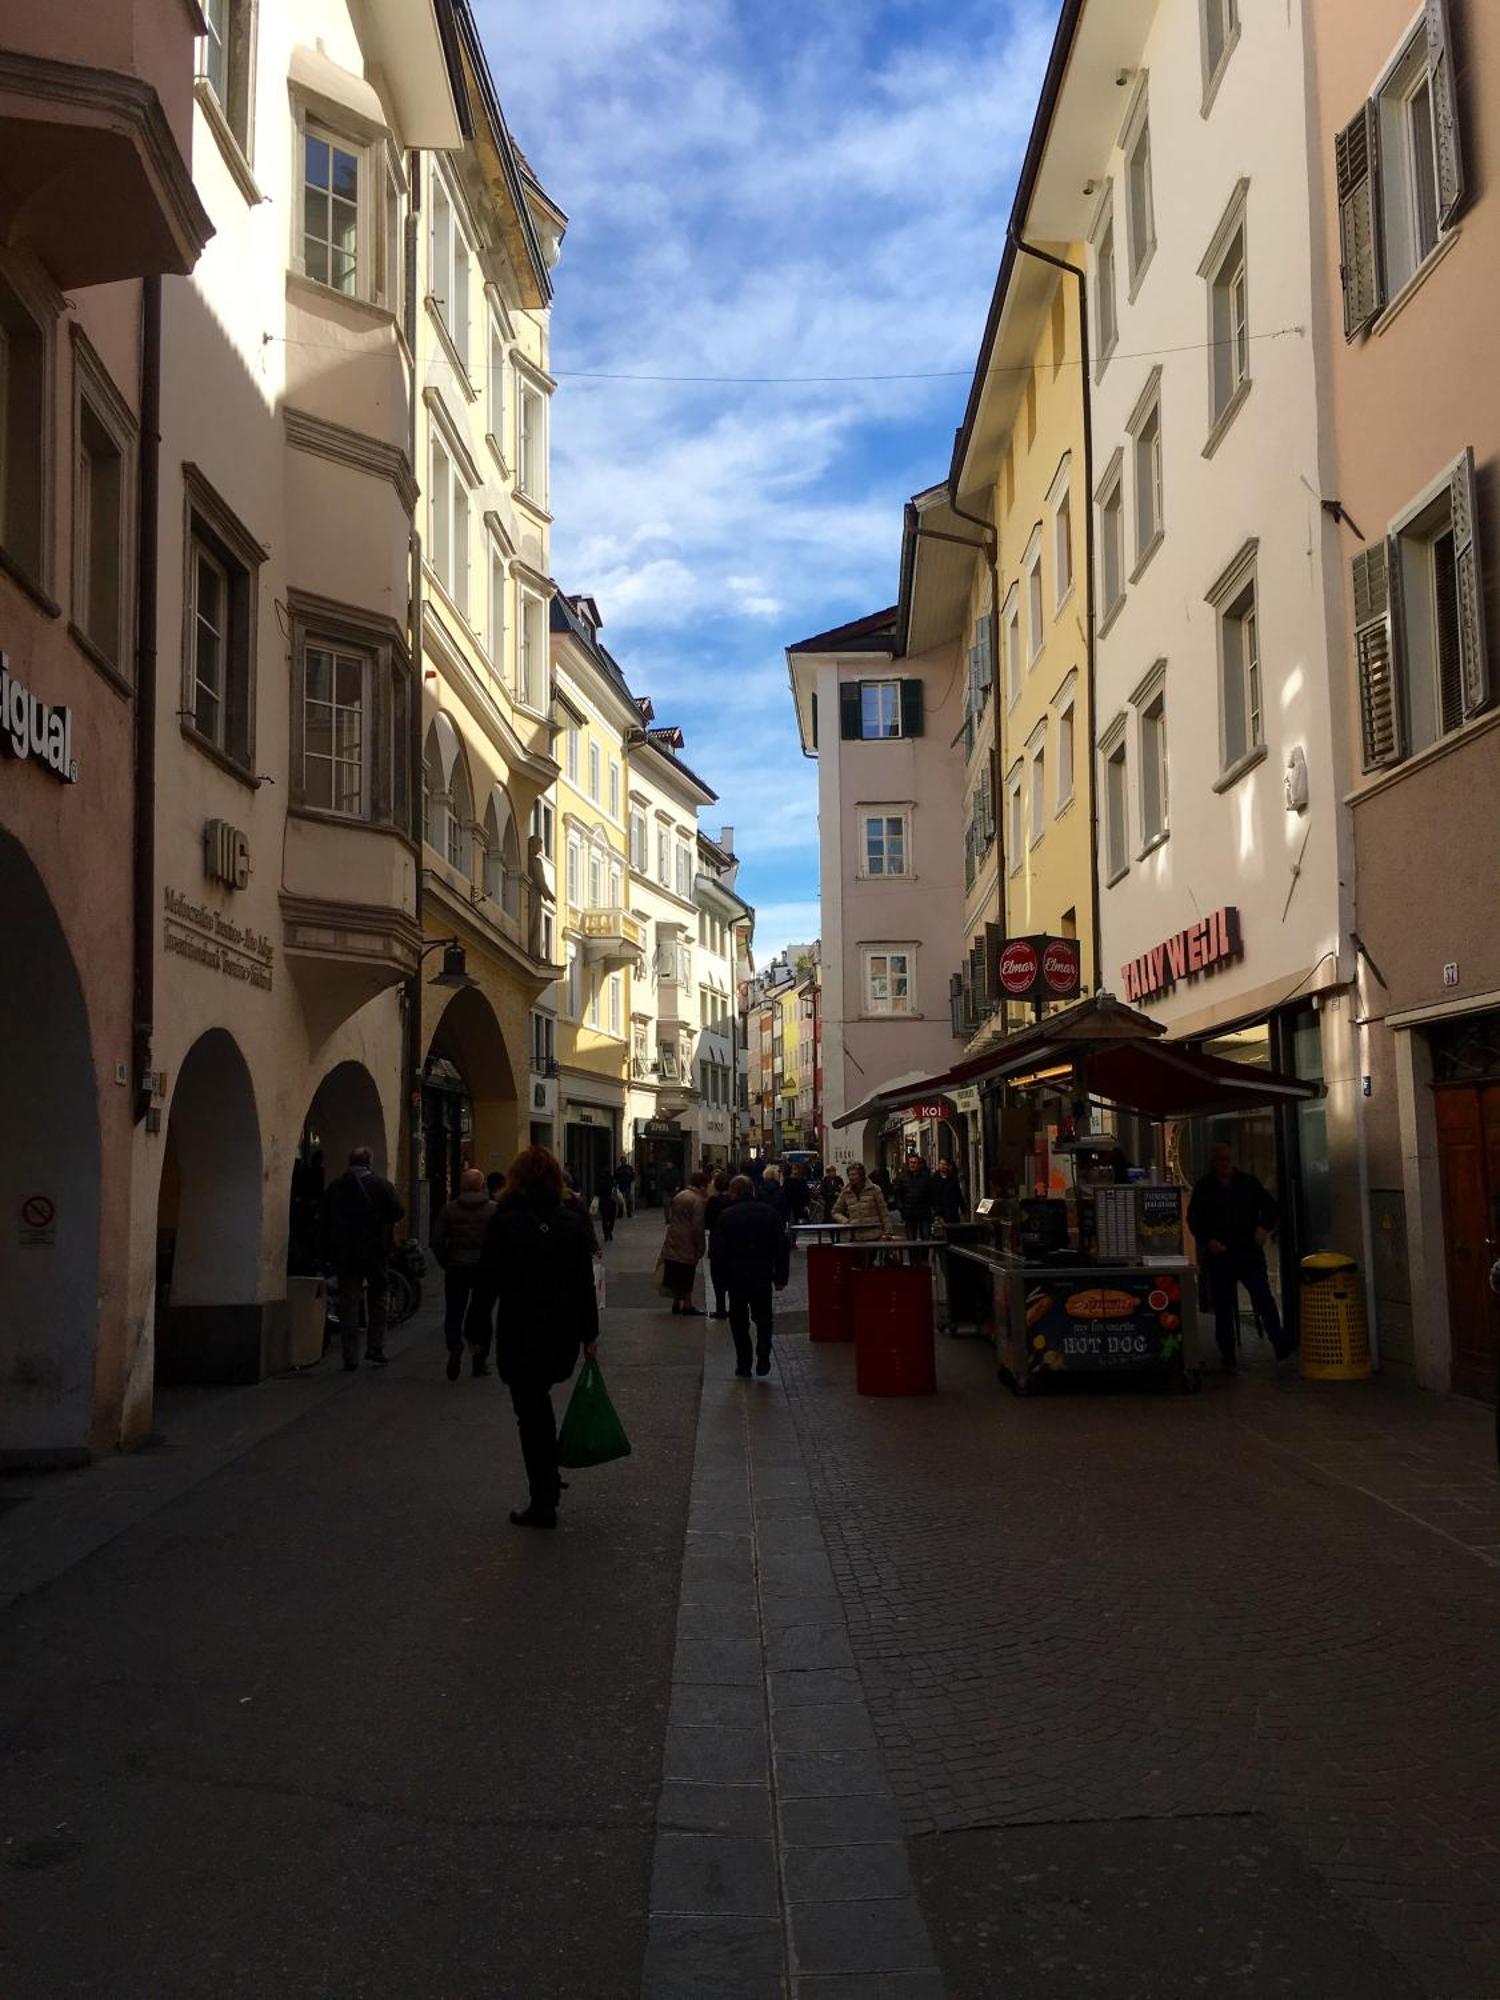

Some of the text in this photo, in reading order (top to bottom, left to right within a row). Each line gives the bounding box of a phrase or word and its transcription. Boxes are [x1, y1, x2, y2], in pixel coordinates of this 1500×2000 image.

[0, 651, 72, 779] igual
[1002, 960, 1035, 975] Elmar
[1044, 958, 1078, 975] Elmar
[1121, 943, 1166, 1003] TALLY
[1063, 1335, 1148, 1355] HOT DOG
